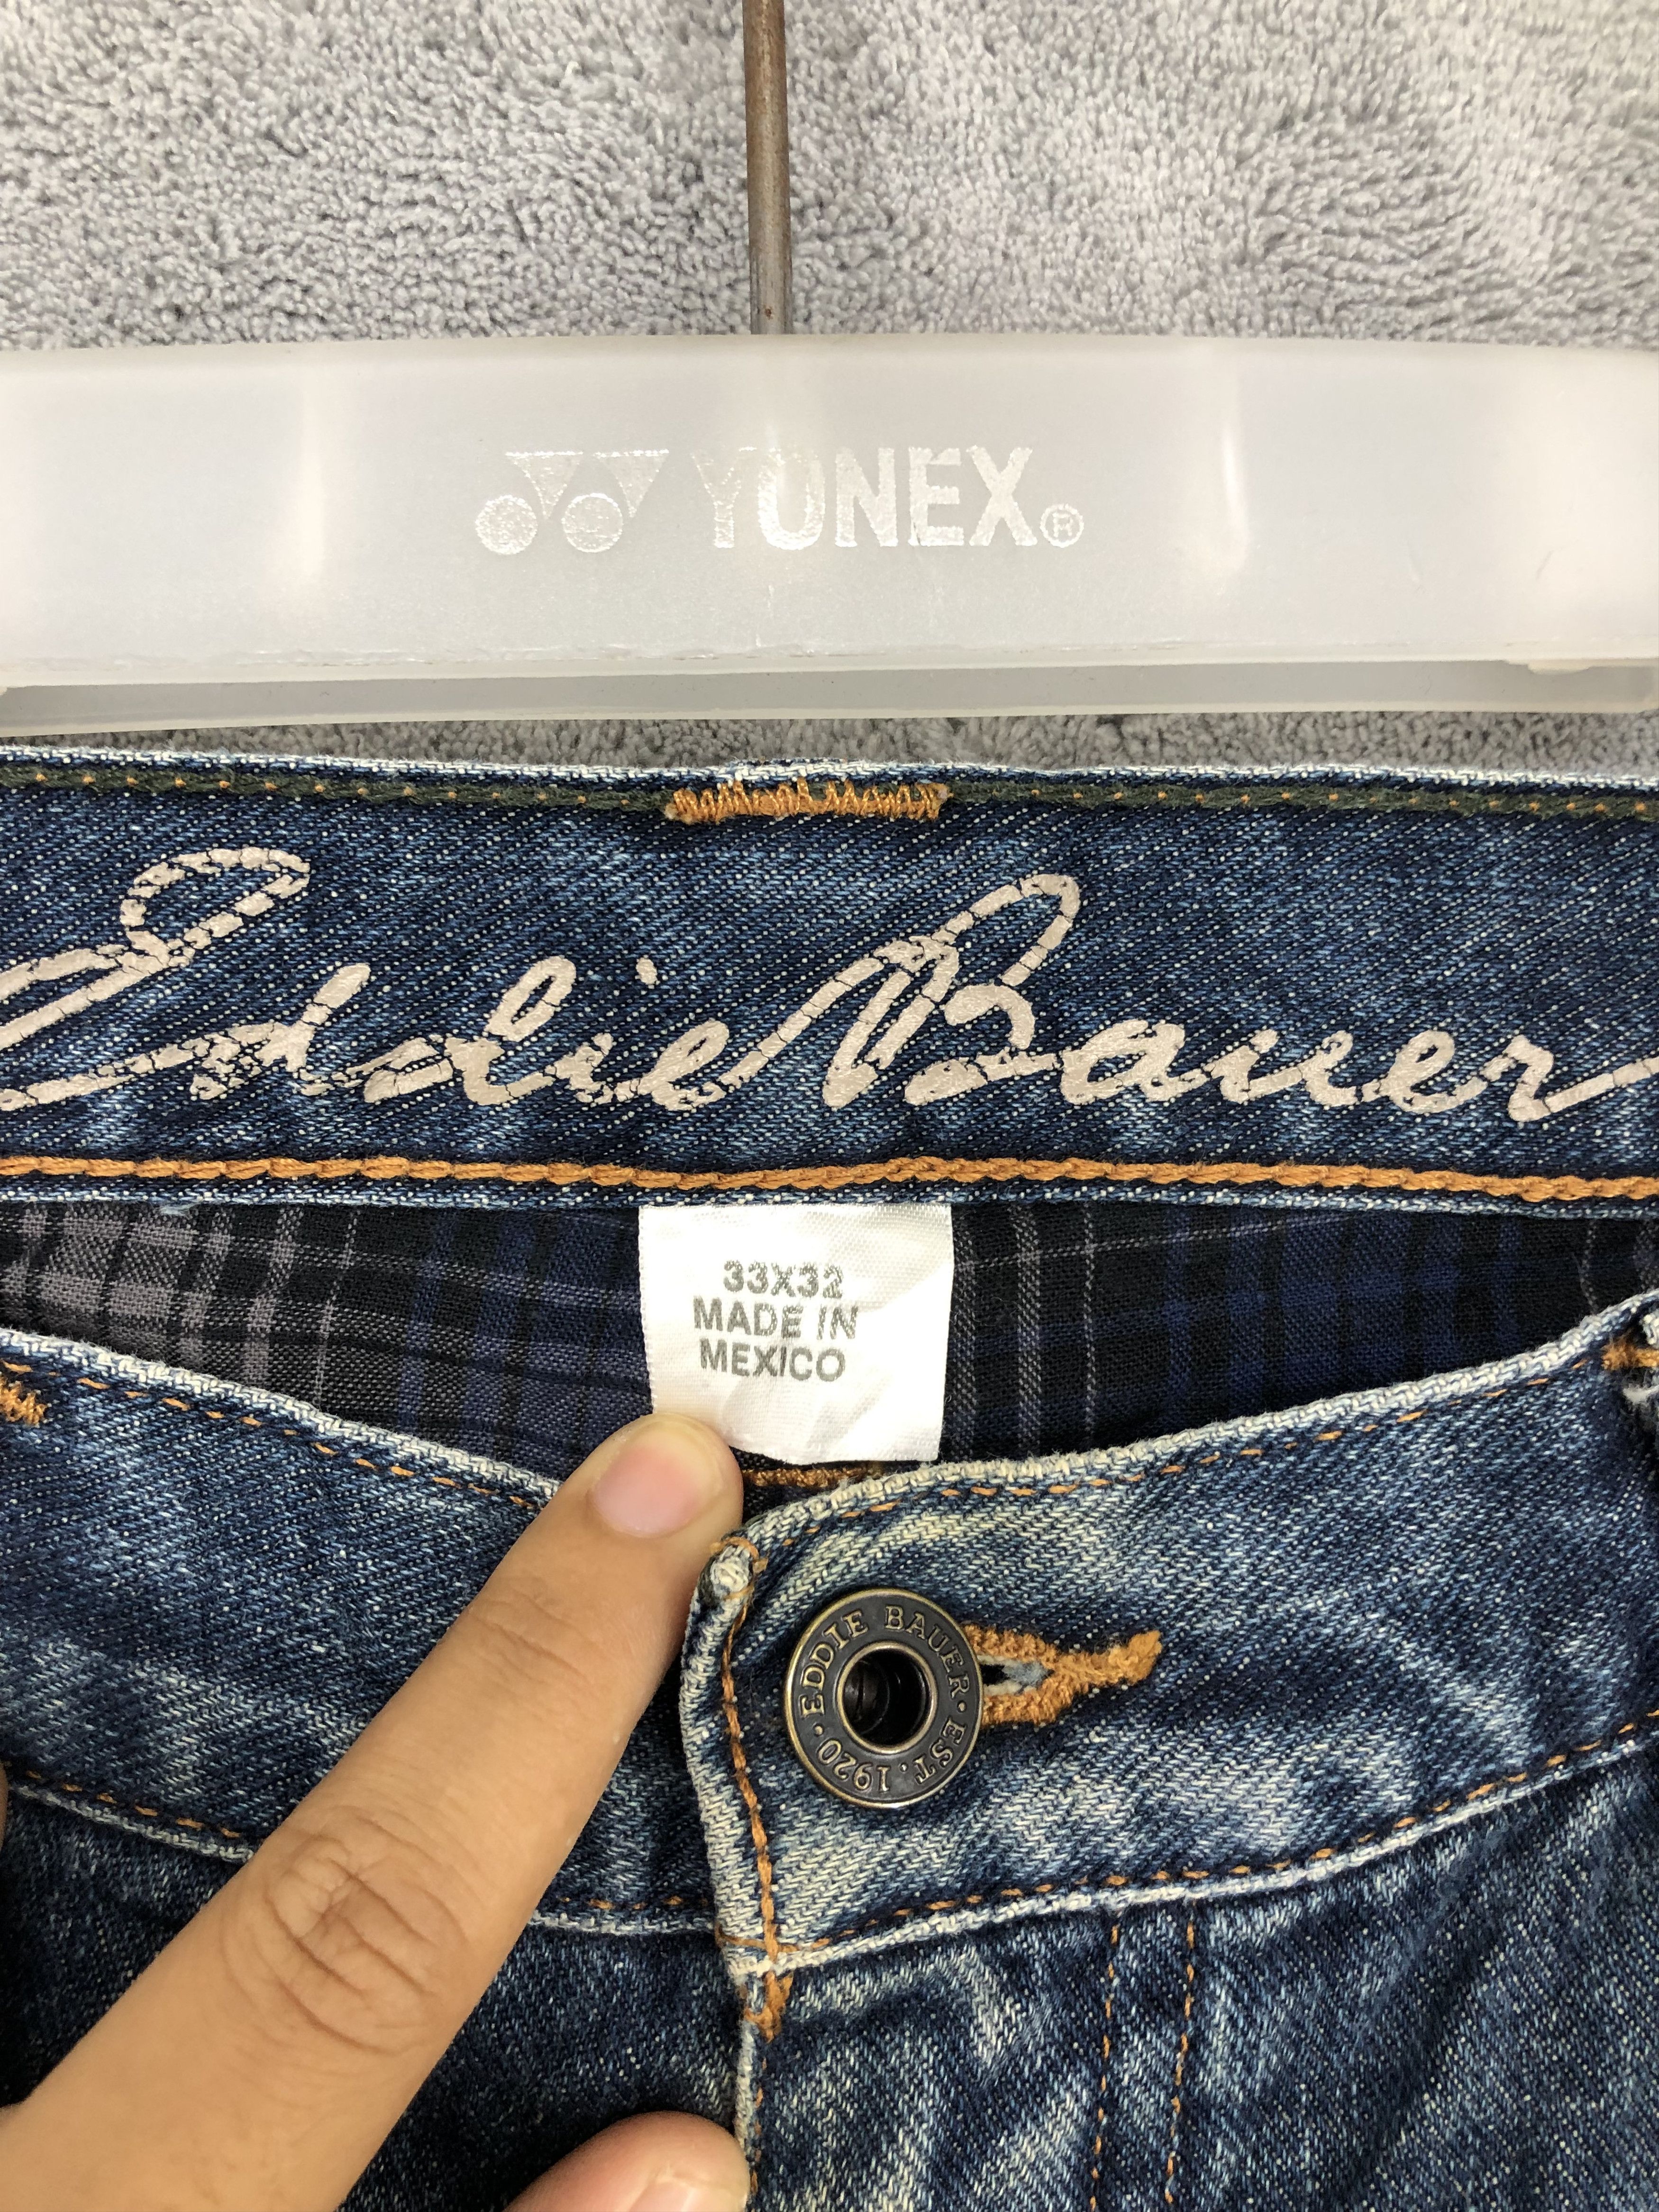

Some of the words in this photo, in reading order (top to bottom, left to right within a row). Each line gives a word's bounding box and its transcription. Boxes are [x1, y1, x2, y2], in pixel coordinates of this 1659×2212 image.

[723, 1259, 844, 1299] 33X32
[693, 1295, 804, 1338] MADE
[816, 1305, 859, 1340] IN
[700, 1338, 846, 1382] MEXICO
[800, 1610, 868, 1719] EDDIE
[884, 1604, 970, 1700] BAUER
[816, 1738, 891, 1793] 1920
